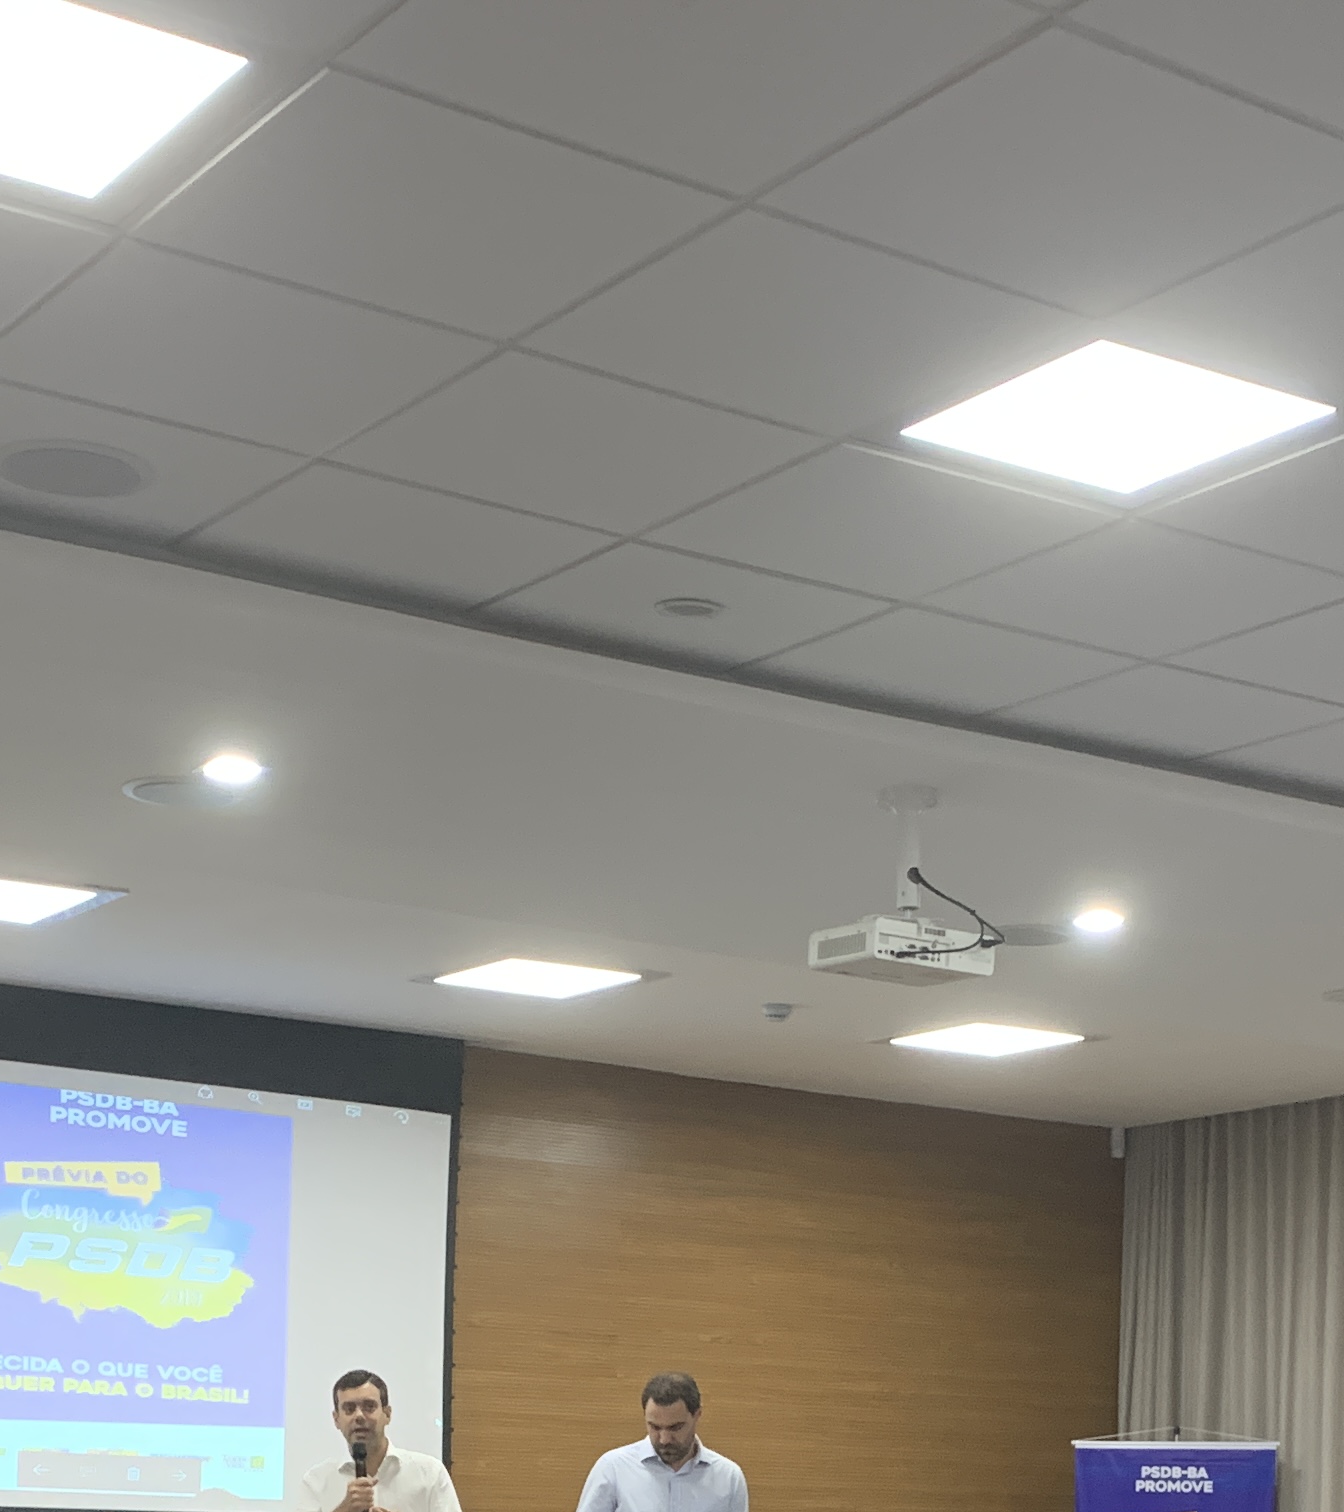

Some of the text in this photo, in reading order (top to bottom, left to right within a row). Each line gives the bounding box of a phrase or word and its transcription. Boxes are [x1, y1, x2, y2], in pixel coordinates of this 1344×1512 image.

[60, 1088, 179, 1116] PSDB-BA
[49, 1105, 188, 1137] PROMOVE
[116, 1171, 148, 1186] DO
[21, 1188, 158, 1233] Congresso
[7, 1231, 236, 1283] PSDB
[71, 1359, 91, 1375] O
[97, 1360, 149, 1379] QUE
[157, 1364, 224, 1383] VOCÊ
[62, 1377, 128, 1397] PARA
[135, 1382, 154, 1398] O
[160, 1383, 250, 1404] BRASIL!
[1140, 1465, 1209, 1479] PSDB-BA
[1135, 1479, 1214, 1494] PROMOVE
